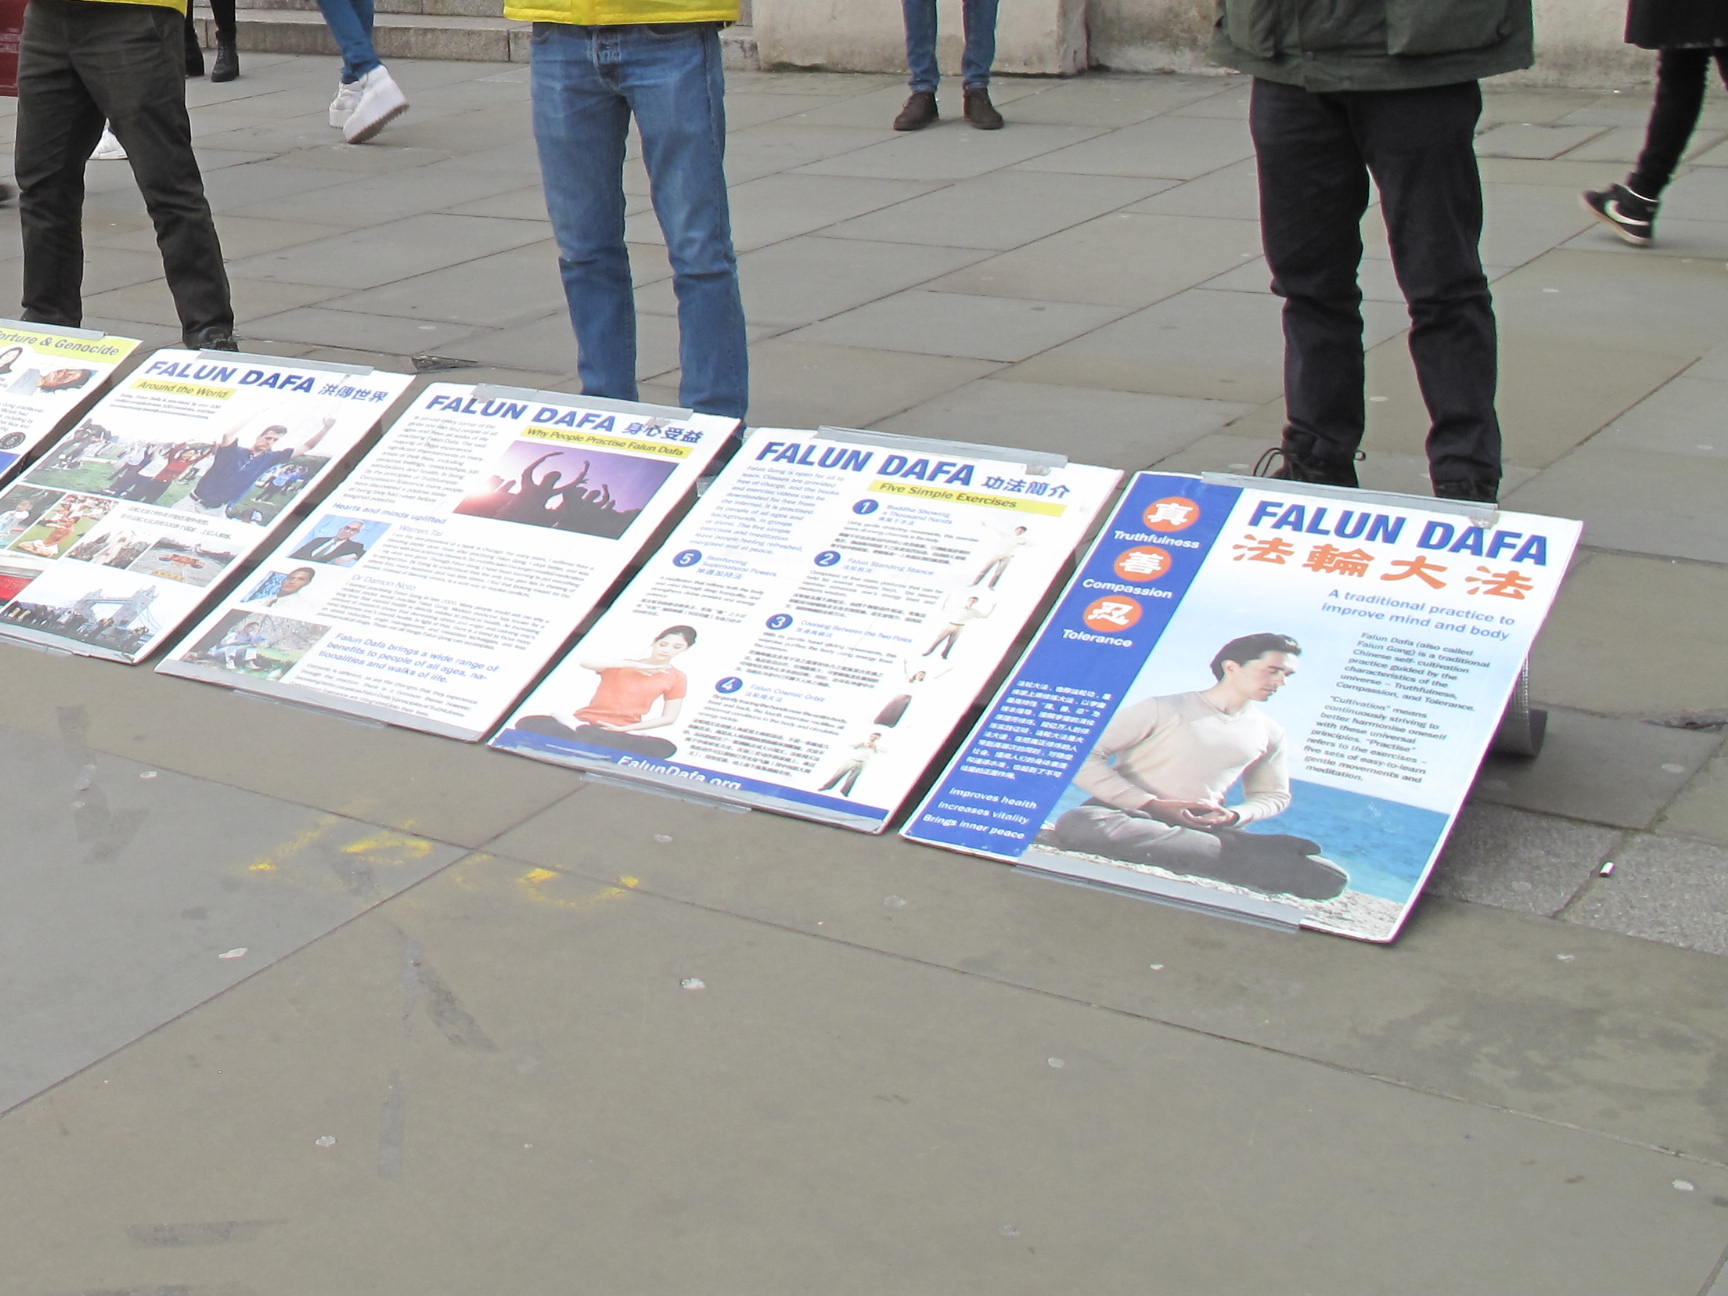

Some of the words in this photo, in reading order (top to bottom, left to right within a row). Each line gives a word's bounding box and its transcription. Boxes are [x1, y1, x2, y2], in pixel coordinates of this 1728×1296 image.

[40, 338, 53, 346] &
[55, 339, 120, 356] Genocide
[144, 360, 238, 384] FALUN
[238, 370, 315, 393] DAFA
[137, 381, 176, 392] Around
[177, 384, 194, 394] the
[196, 387, 229, 398] World
[425, 394, 526, 420] FALUN
[531, 406, 617, 432] DAFA
[526, 427, 550, 439] Why
[551, 430, 584, 444] People
[585, 434, 625, 447] Practise
[626, 440, 654, 452] Falun
[656, 444, 684, 455] Dafa
[622, 422, 704, 443] 身心受益
[755, 441, 874, 472] FALUN
[877, 455, 975, 486] DAFA
[880, 483, 906, 493] Five
[908, 487, 954, 500] Simple
[956, 492, 1017, 508] Exercises
[981, 476, 1070, 499] 功法簡介
[333, 502, 360, 513] Hearts
[362, 507, 380, 515] and
[381, 509, 409, 519] minds
[411, 514, 446, 525] uplifted
[860, 502, 872, 512] 1
[1147, 502, 1193, 525] 真
[1114, 530, 1200, 549] Truthfulness
[1248, 500, 1407, 544] FALUN
[1417, 521, 1547, 566] DAFA
[680, 552, 695, 564] 5
[819, 553, 834, 565] 2
[1120, 552, 1164, 574] 善
[1232, 535, 1533, 600] 法輪大法
[1083, 579, 1172, 599] Compassion
[1088, 602, 1133, 625] 忍
[1328, 589, 1341, 598] A
[1344, 591, 1425, 612] traditional
[1428, 602, 1494, 625] practice
[1498, 616, 1515, 626] to
[772, 616, 786, 629] 3
[1322, 604, 1385, 623] improve
[1388, 611, 1431, 628] mind
[1434, 620, 1466, 634] and
[1470, 624, 1510, 642] body
[1063, 629, 1133, 647] Tolerance
[1361, 633, 1387, 643] Falun
[1390, 637, 1414, 646] Dafa
[1443, 645, 1473, 655] called
[1353, 649, 1392, 660] Chinese
[1417, 658, 1469, 674] cultivation
[1357, 641, 1384, 651] Falun
[1386, 645, 1416, 656] Gong)
[1438, 653, 1490, 668] traditional
[1344, 666, 1416, 683] characteristics
[1419, 676, 1430, 684] of
[1431, 678, 1448, 688] the
[1348, 658, 1387, 670] practice
[1389, 663, 1424, 675] guided
[1427, 669, 1439, 678] by
[1441, 671, 1458, 680] the
[721, 679, 734, 692] 4
[1340, 675, 1382, 686] universe
[1401, 693, 1422, 702] and
[617, 755, 742, 790] FalunDafaorg
[1001, 796, 1037, 809] health
[923, 814, 956, 827] Brings
[959, 820, 988, 832] inner
[989, 827, 1025, 839] peace
[992, 810, 1029, 825] vitality
